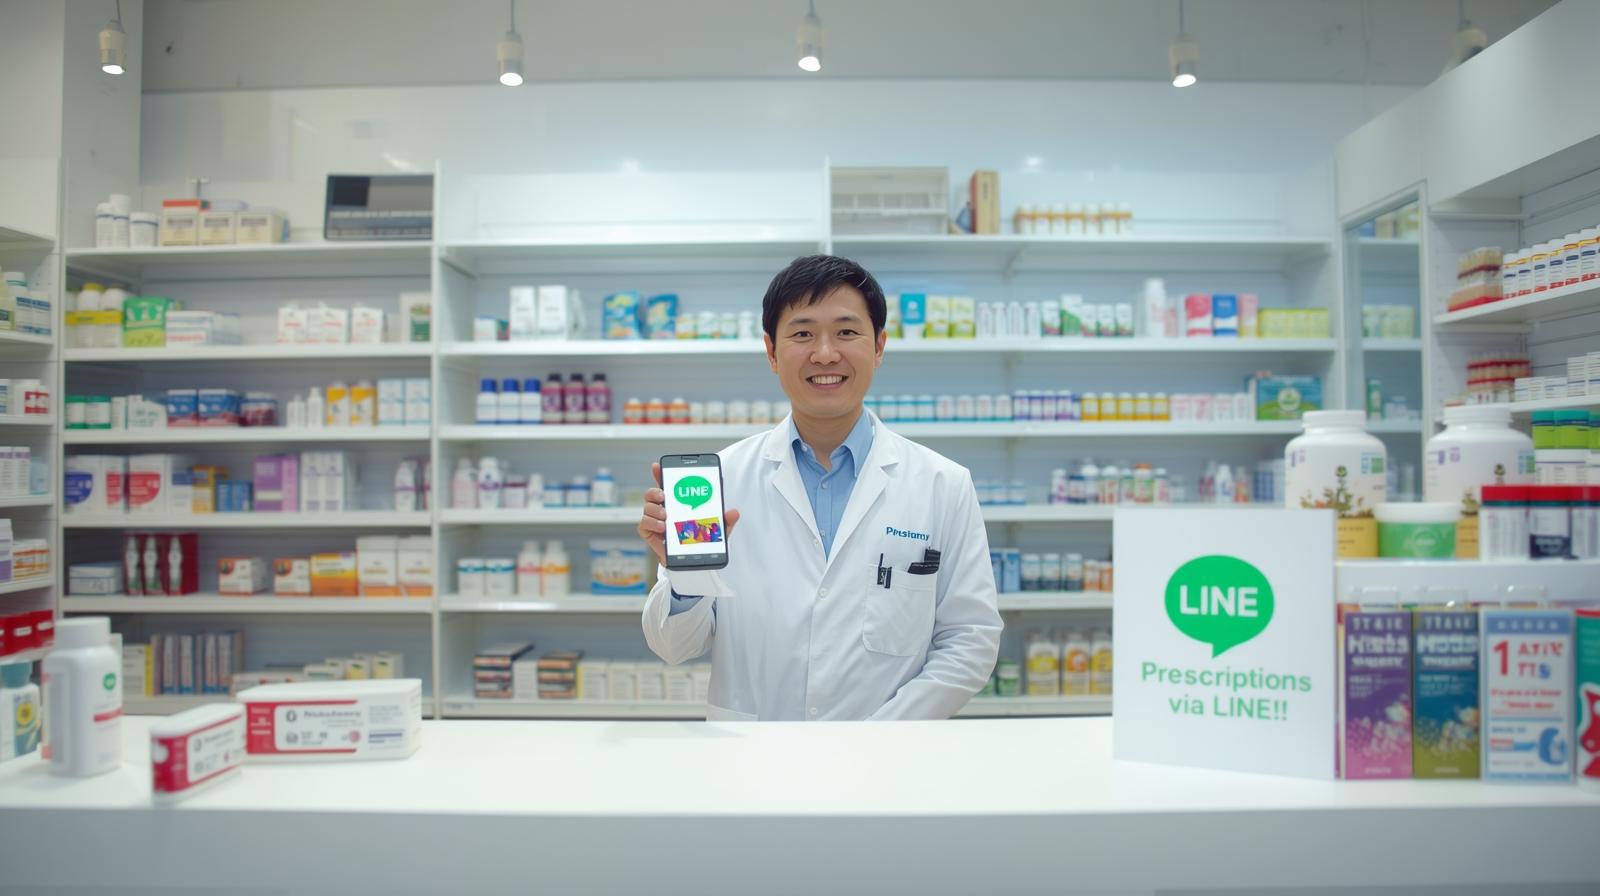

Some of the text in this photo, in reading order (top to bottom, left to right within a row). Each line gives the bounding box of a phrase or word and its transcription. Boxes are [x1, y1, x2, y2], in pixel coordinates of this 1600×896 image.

[678, 485, 708, 498] LINE
[1179, 585, 1258, 617] LINE
[1141, 661, 1312, 693] Prescriptions
[1169, 694, 1288, 721] via LINE!!
